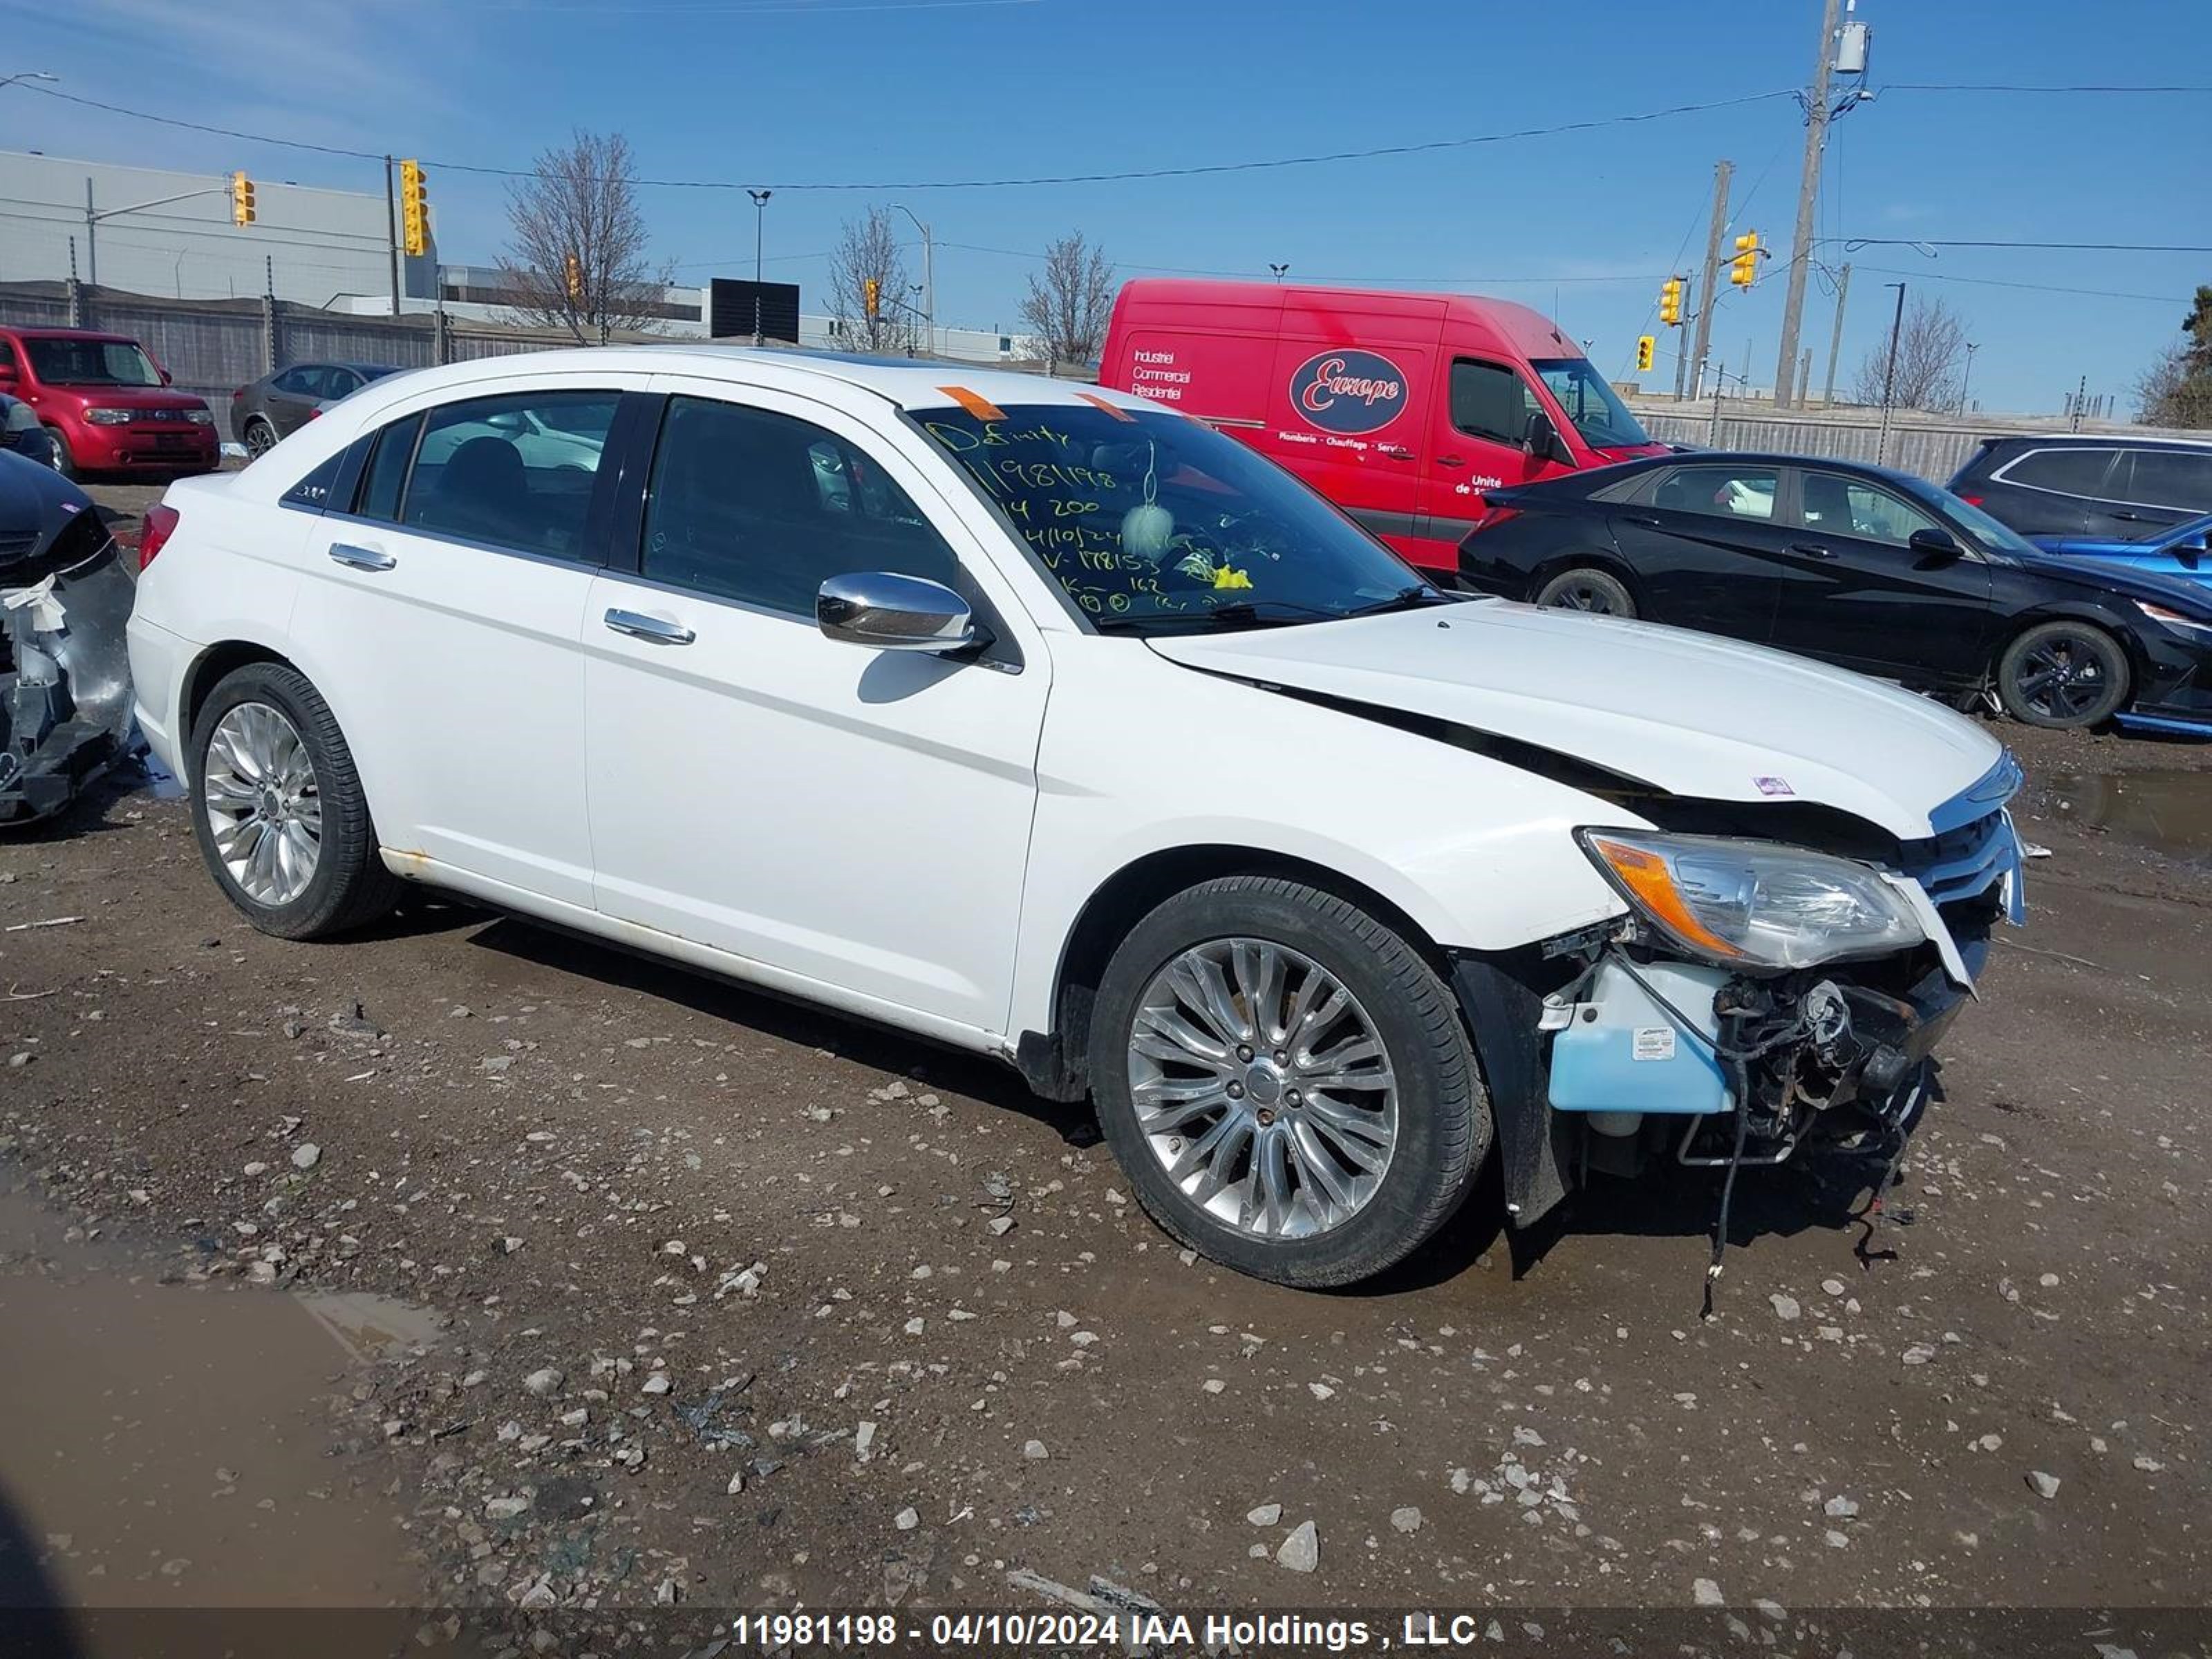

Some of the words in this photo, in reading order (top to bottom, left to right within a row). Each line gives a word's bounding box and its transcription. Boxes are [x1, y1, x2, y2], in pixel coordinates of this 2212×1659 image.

[1134, 350, 1174, 364] Industriel
[1133, 366, 1190, 383] Commercial
[1302, 358, 1399, 411] Europe
[1279, 431, 1316, 444] Plomberie
[1327, 437, 1368, 451] Chauffage
[964, 459, 1116, 498] 11981198
[1472, 474, 1501, 488] Unité
[1456, 483, 1470, 494] de
[1049, 499, 1099, 516] 200
